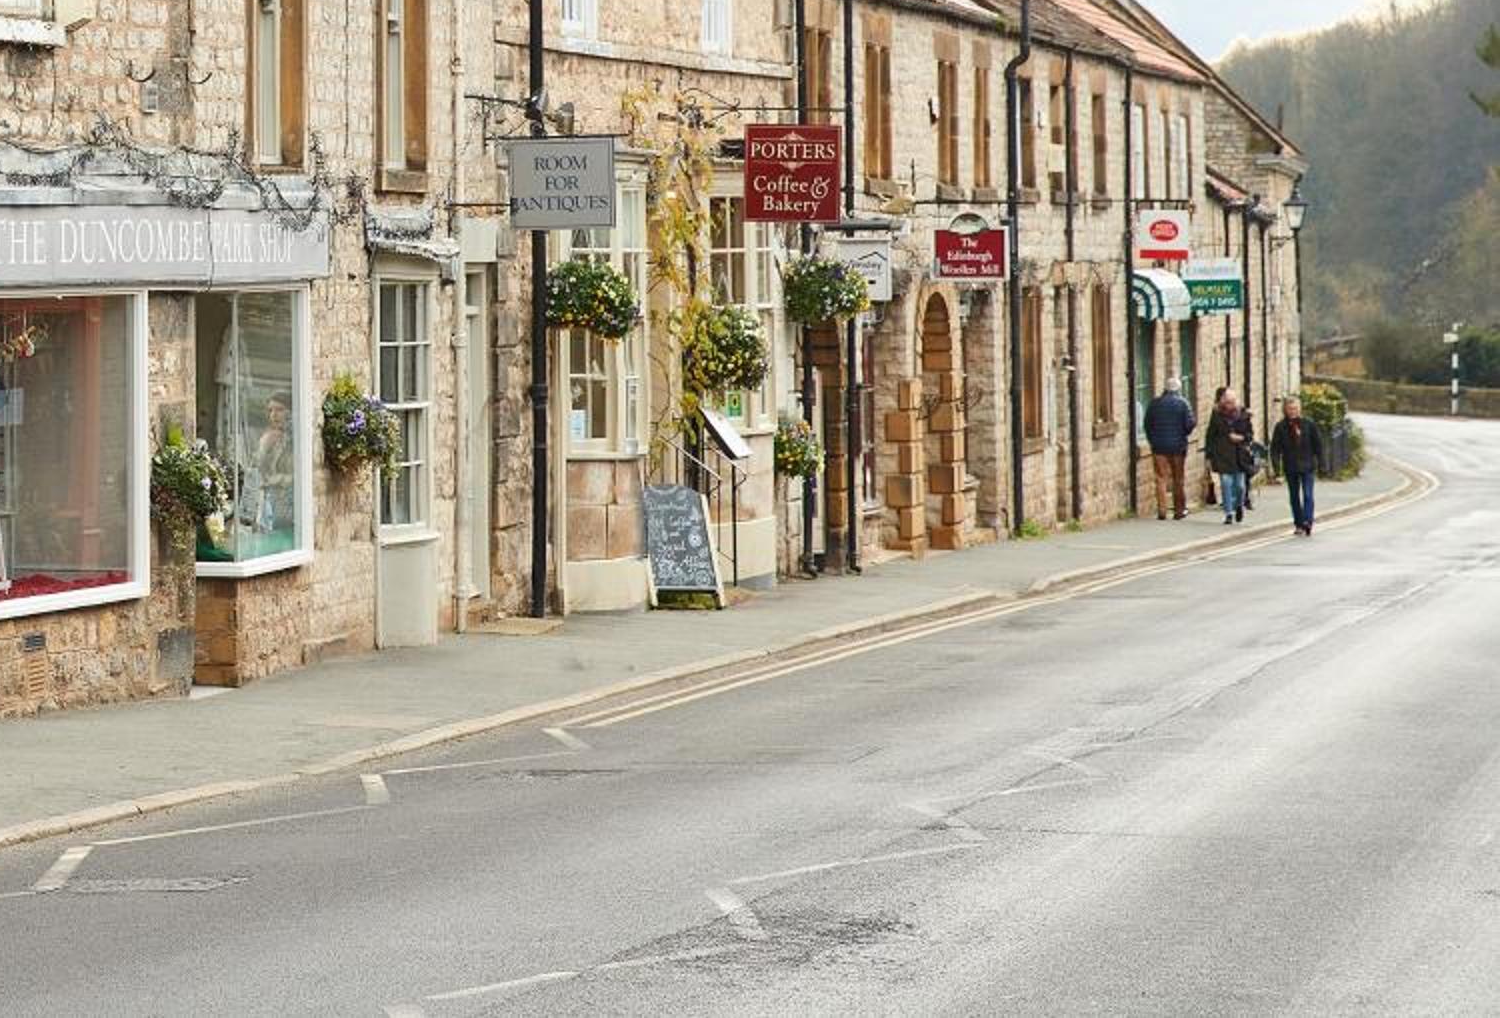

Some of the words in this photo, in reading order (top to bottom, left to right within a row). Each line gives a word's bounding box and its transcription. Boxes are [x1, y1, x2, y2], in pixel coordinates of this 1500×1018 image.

[751, 142, 836, 159] PORTERS
[534, 154, 587, 171] ROOM
[545, 175, 579, 191] FOR
[753, 174, 809, 193] Coffee
[810, 176, 831, 199] &
[518, 194, 609, 213] ANTIQUES
[763, 193, 820, 219] Bakery
[58, 218, 205, 264] DUNCOMBE
[211, 221, 254, 263] PARK
[259, 222, 295, 263] SHOP
[960, 237, 979, 248] The
[947, 250, 993, 263] Edinburgh
